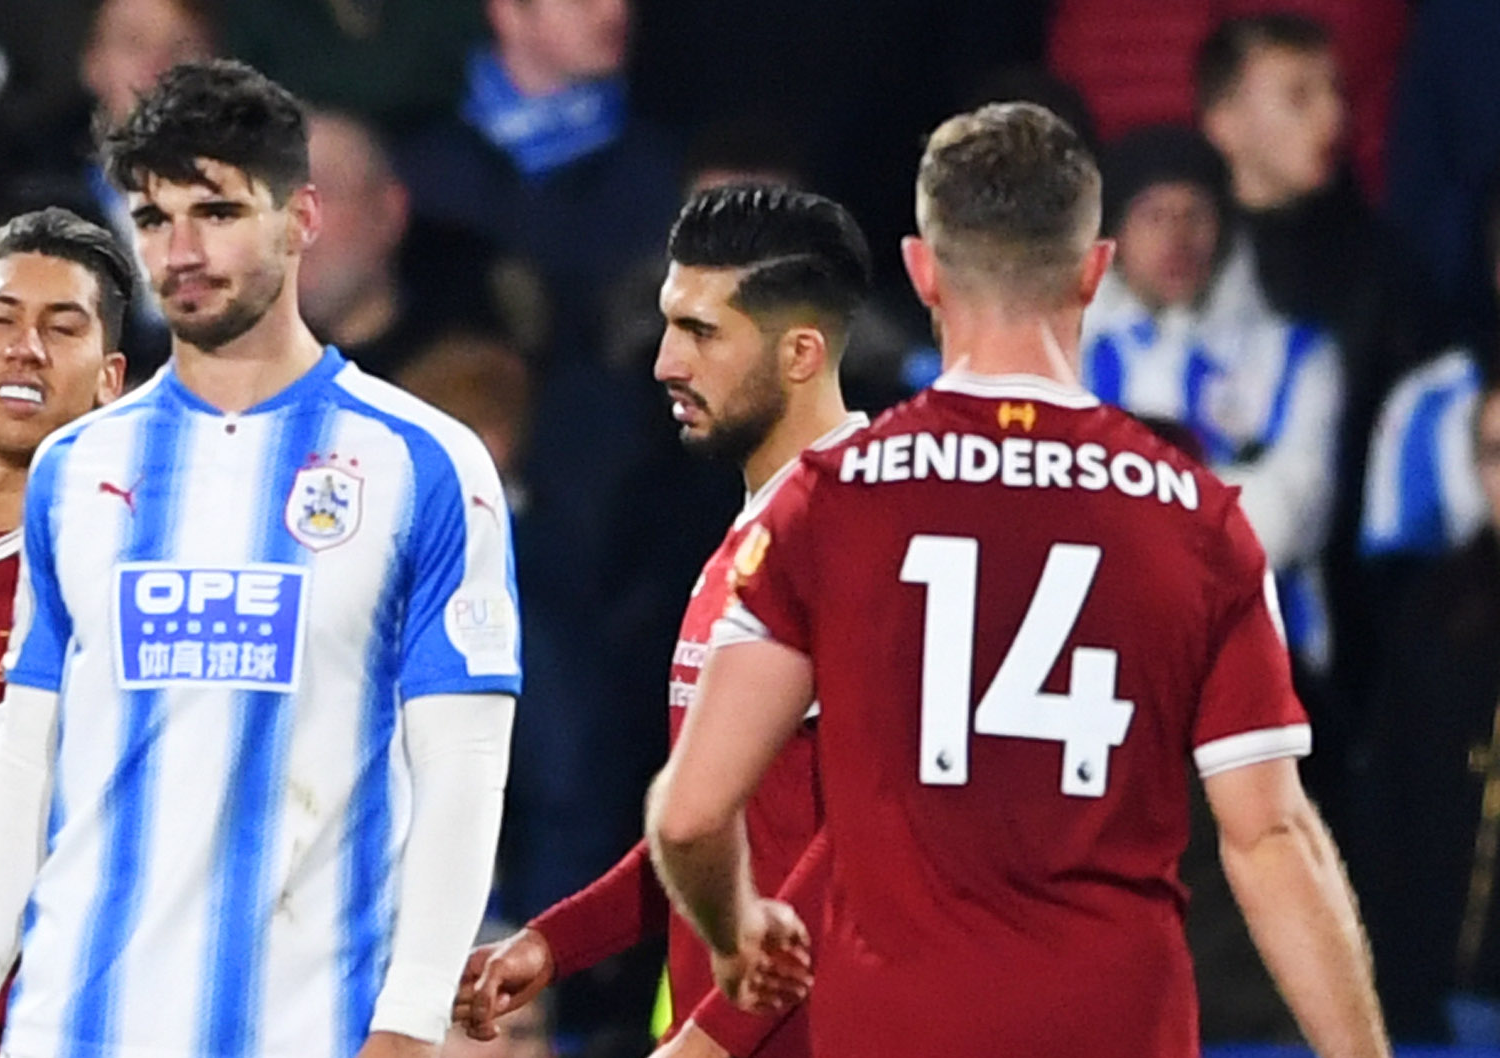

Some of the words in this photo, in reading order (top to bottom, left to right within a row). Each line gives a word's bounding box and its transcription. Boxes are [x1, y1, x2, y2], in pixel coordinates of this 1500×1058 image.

[839, 431, 1198, 511] HENDERSON
[135, 571, 283, 616] OPE
[899, 533, 1134, 797] 14
